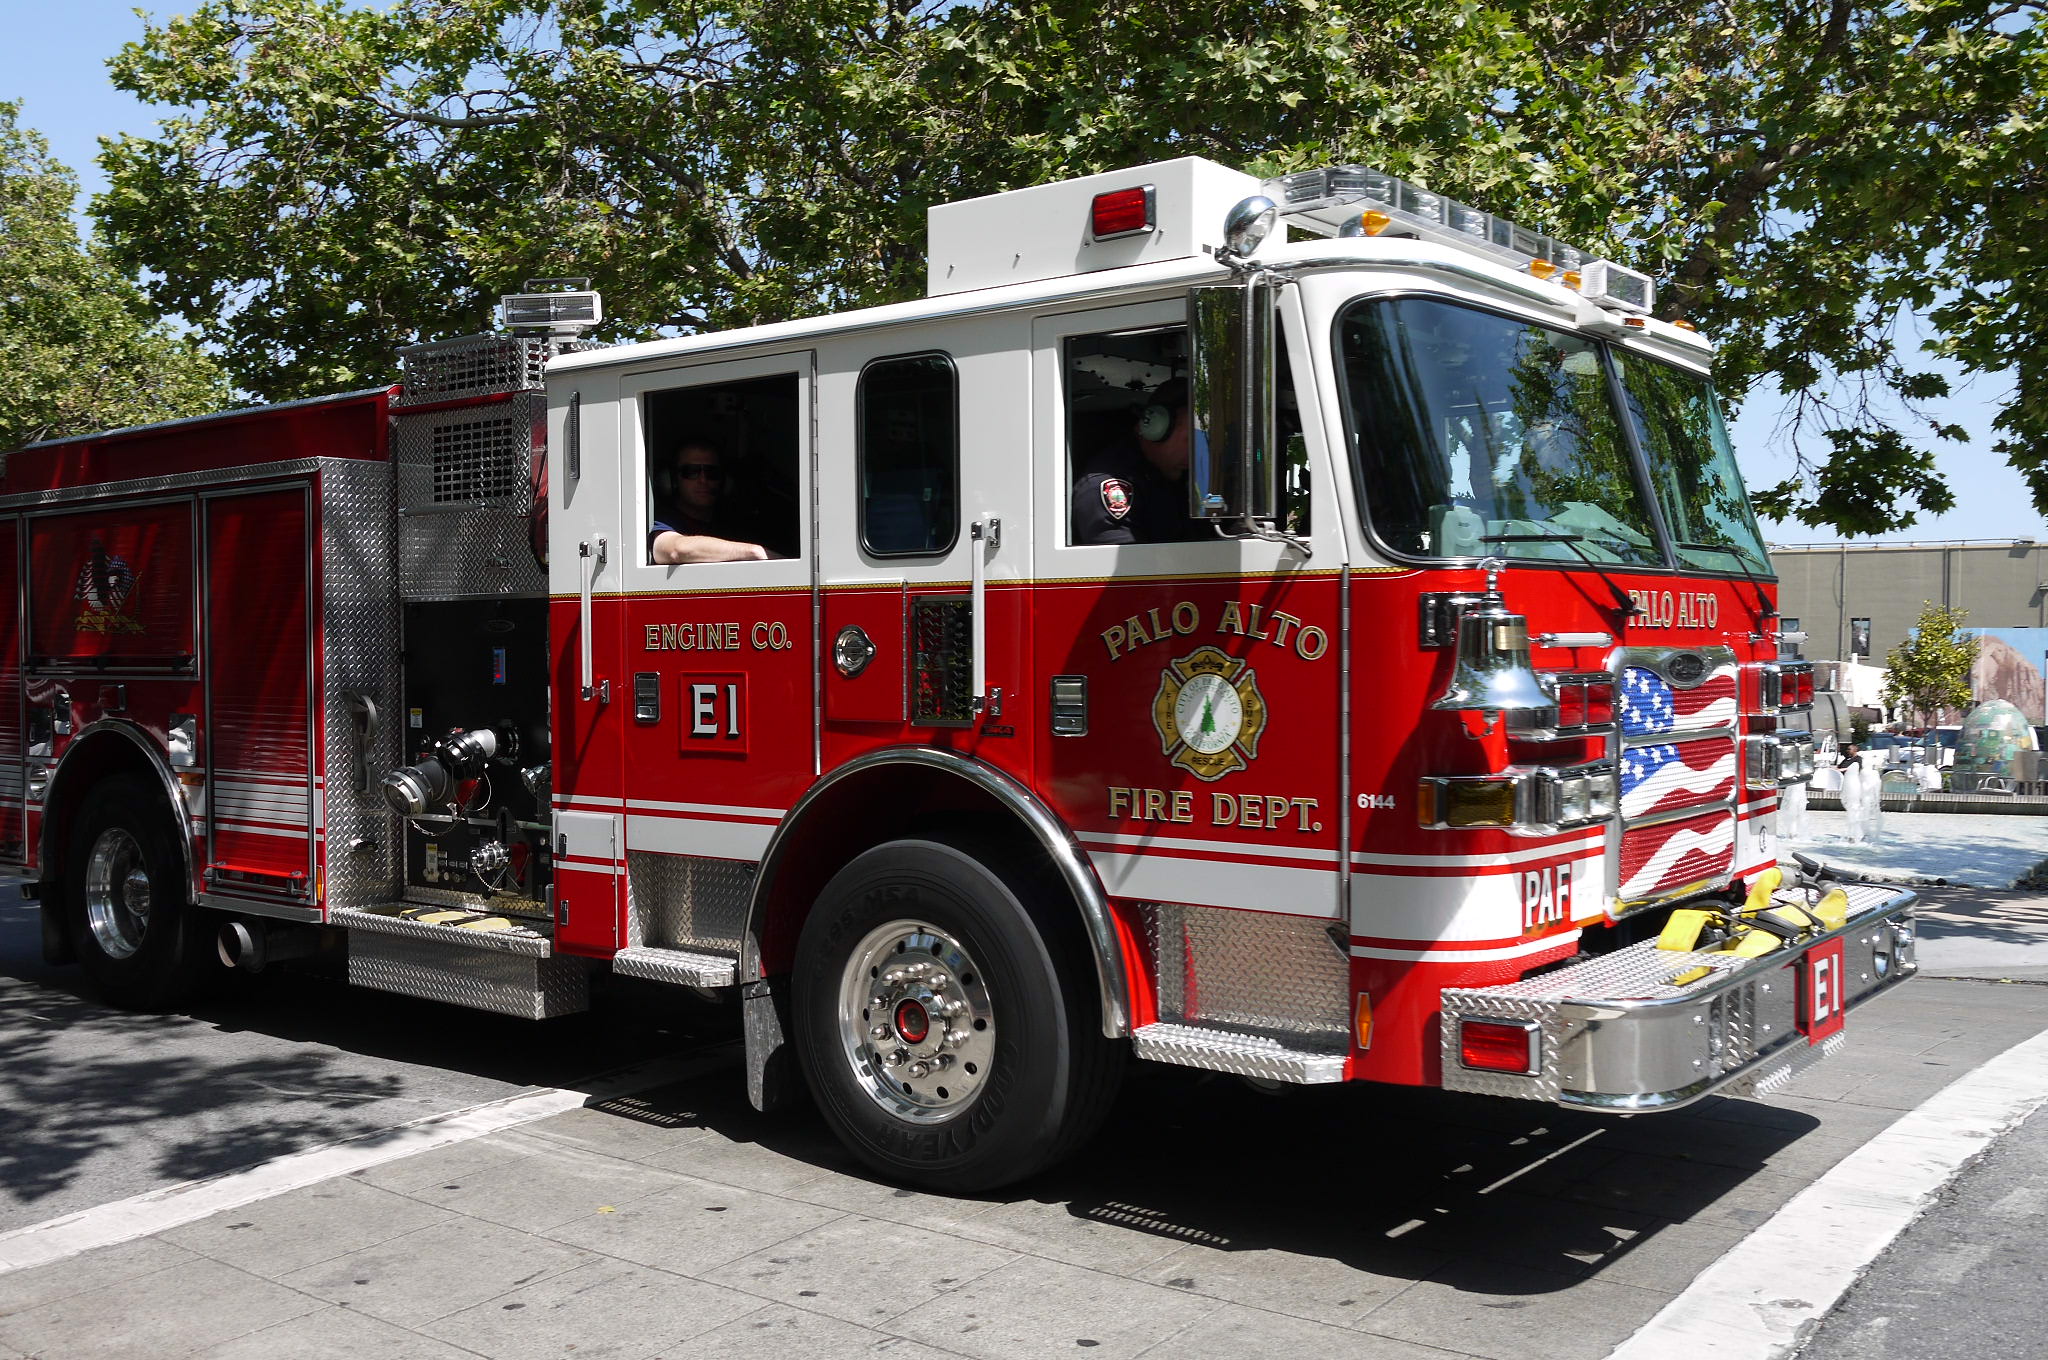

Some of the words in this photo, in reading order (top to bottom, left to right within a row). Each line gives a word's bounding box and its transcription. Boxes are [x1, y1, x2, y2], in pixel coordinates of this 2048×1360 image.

[1100, 601, 1199, 661] PALO
[1216, 600, 1328, 661] ALTO
[1627, 589, 1675, 628] PALO
[1676, 592, 1719, 628] ALTO
[644, 622, 741, 650] ENGINE
[751, 621, 793, 650] CO.
[690, 684, 740, 735] E1
[1108, 786, 1194, 823] FIRE
[1211, 792, 1323, 832] DEPT.
[1357, 793, 1396, 810] 6144
[1524, 863, 1571, 928] PAF
[1814, 953, 1840, 1022] E1
